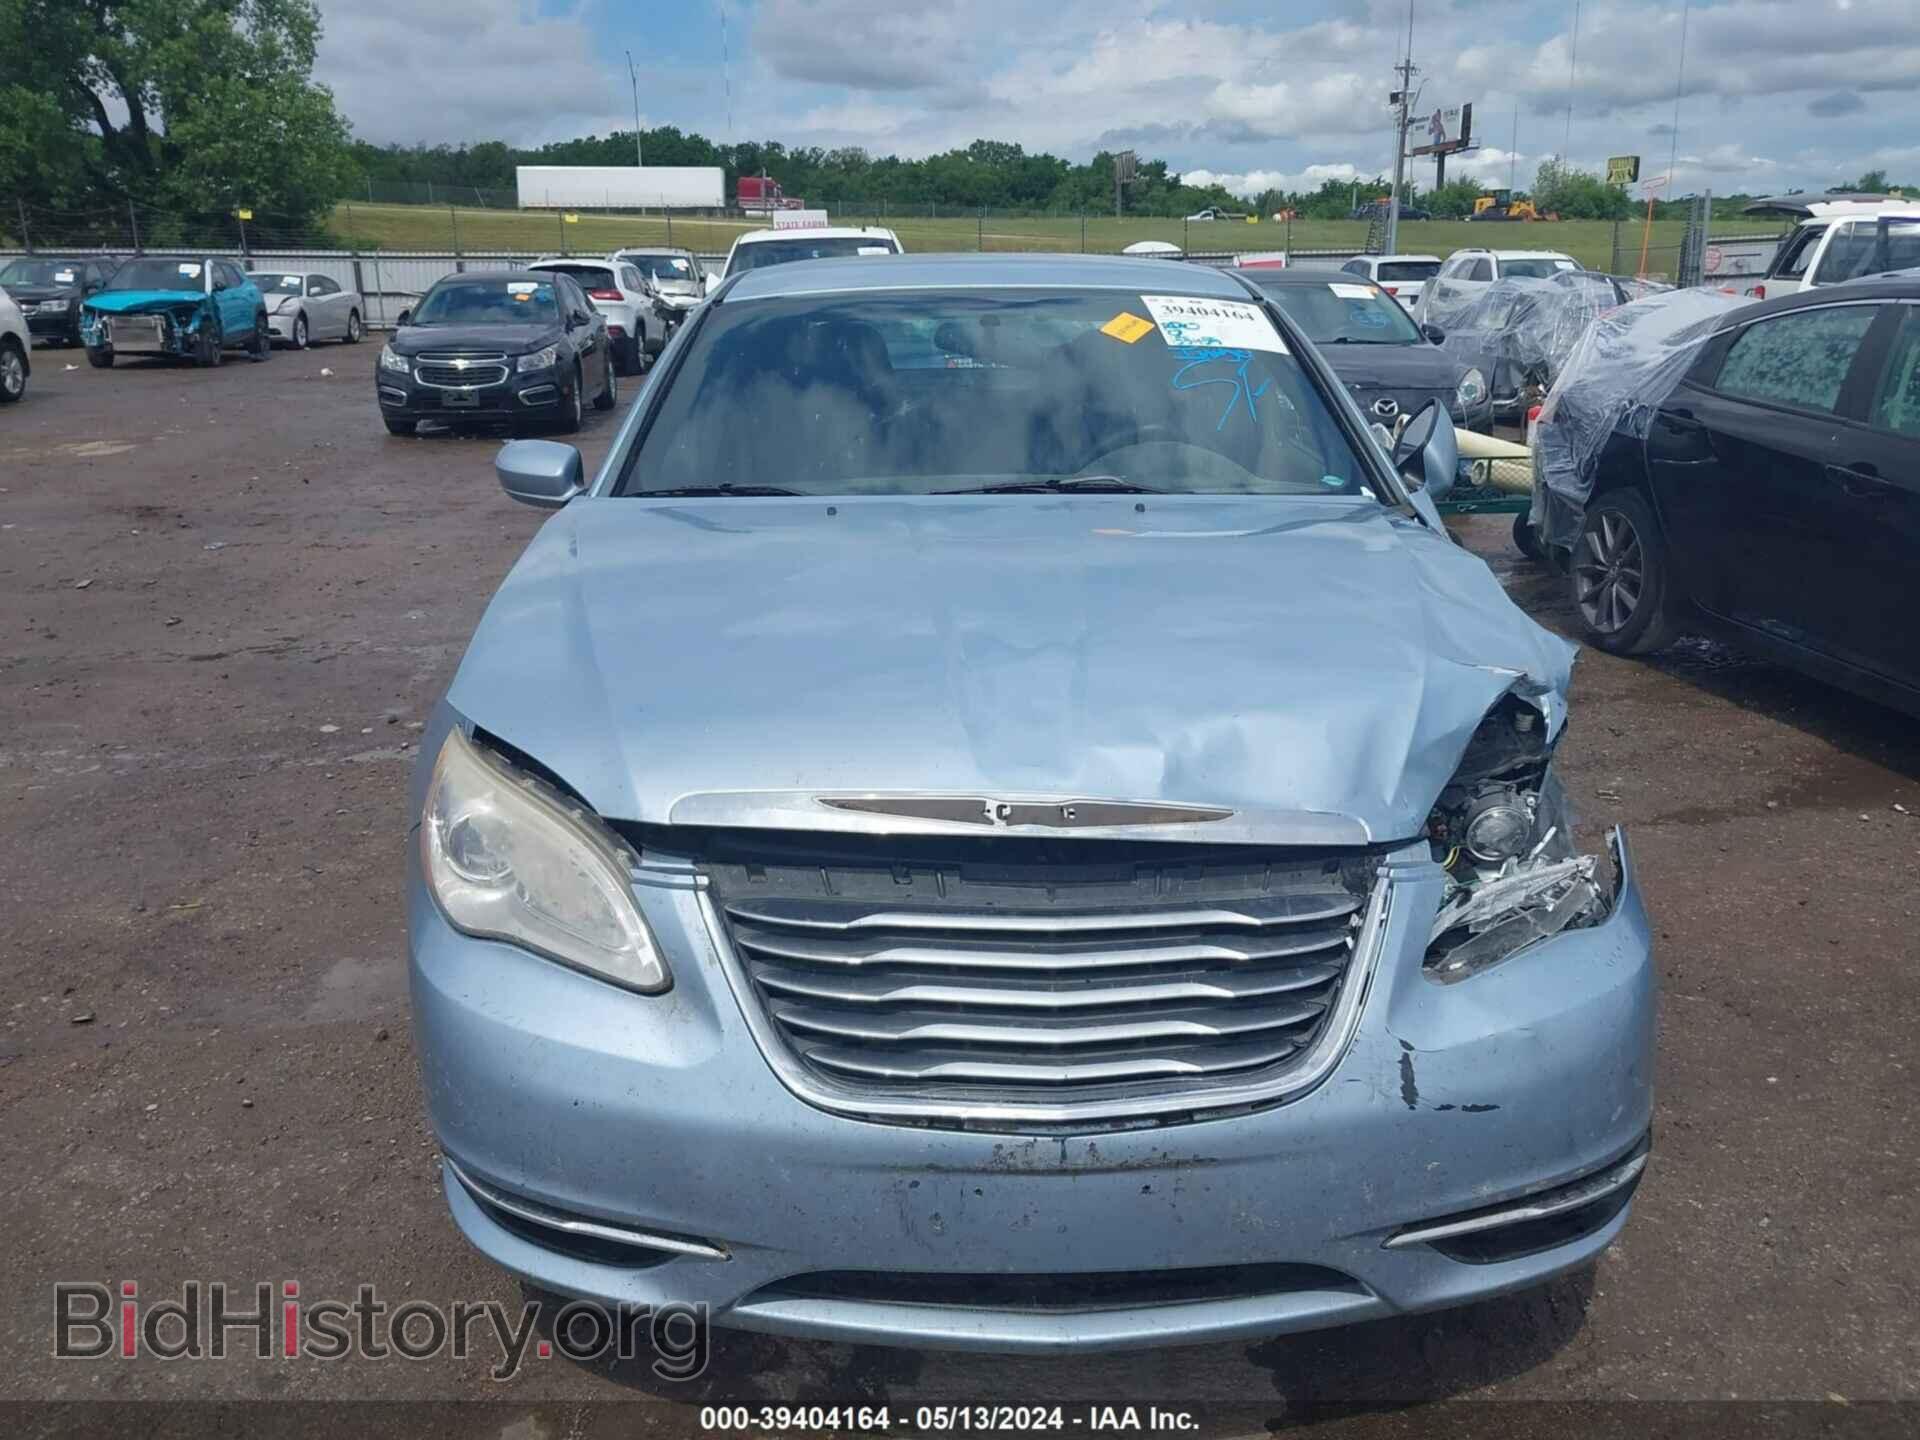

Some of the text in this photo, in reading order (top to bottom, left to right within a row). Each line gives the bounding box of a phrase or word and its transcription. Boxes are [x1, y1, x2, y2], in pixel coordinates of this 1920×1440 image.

[775, 220, 826, 231] STATE FARM
[1162, 304, 1256, 321] 39404164
